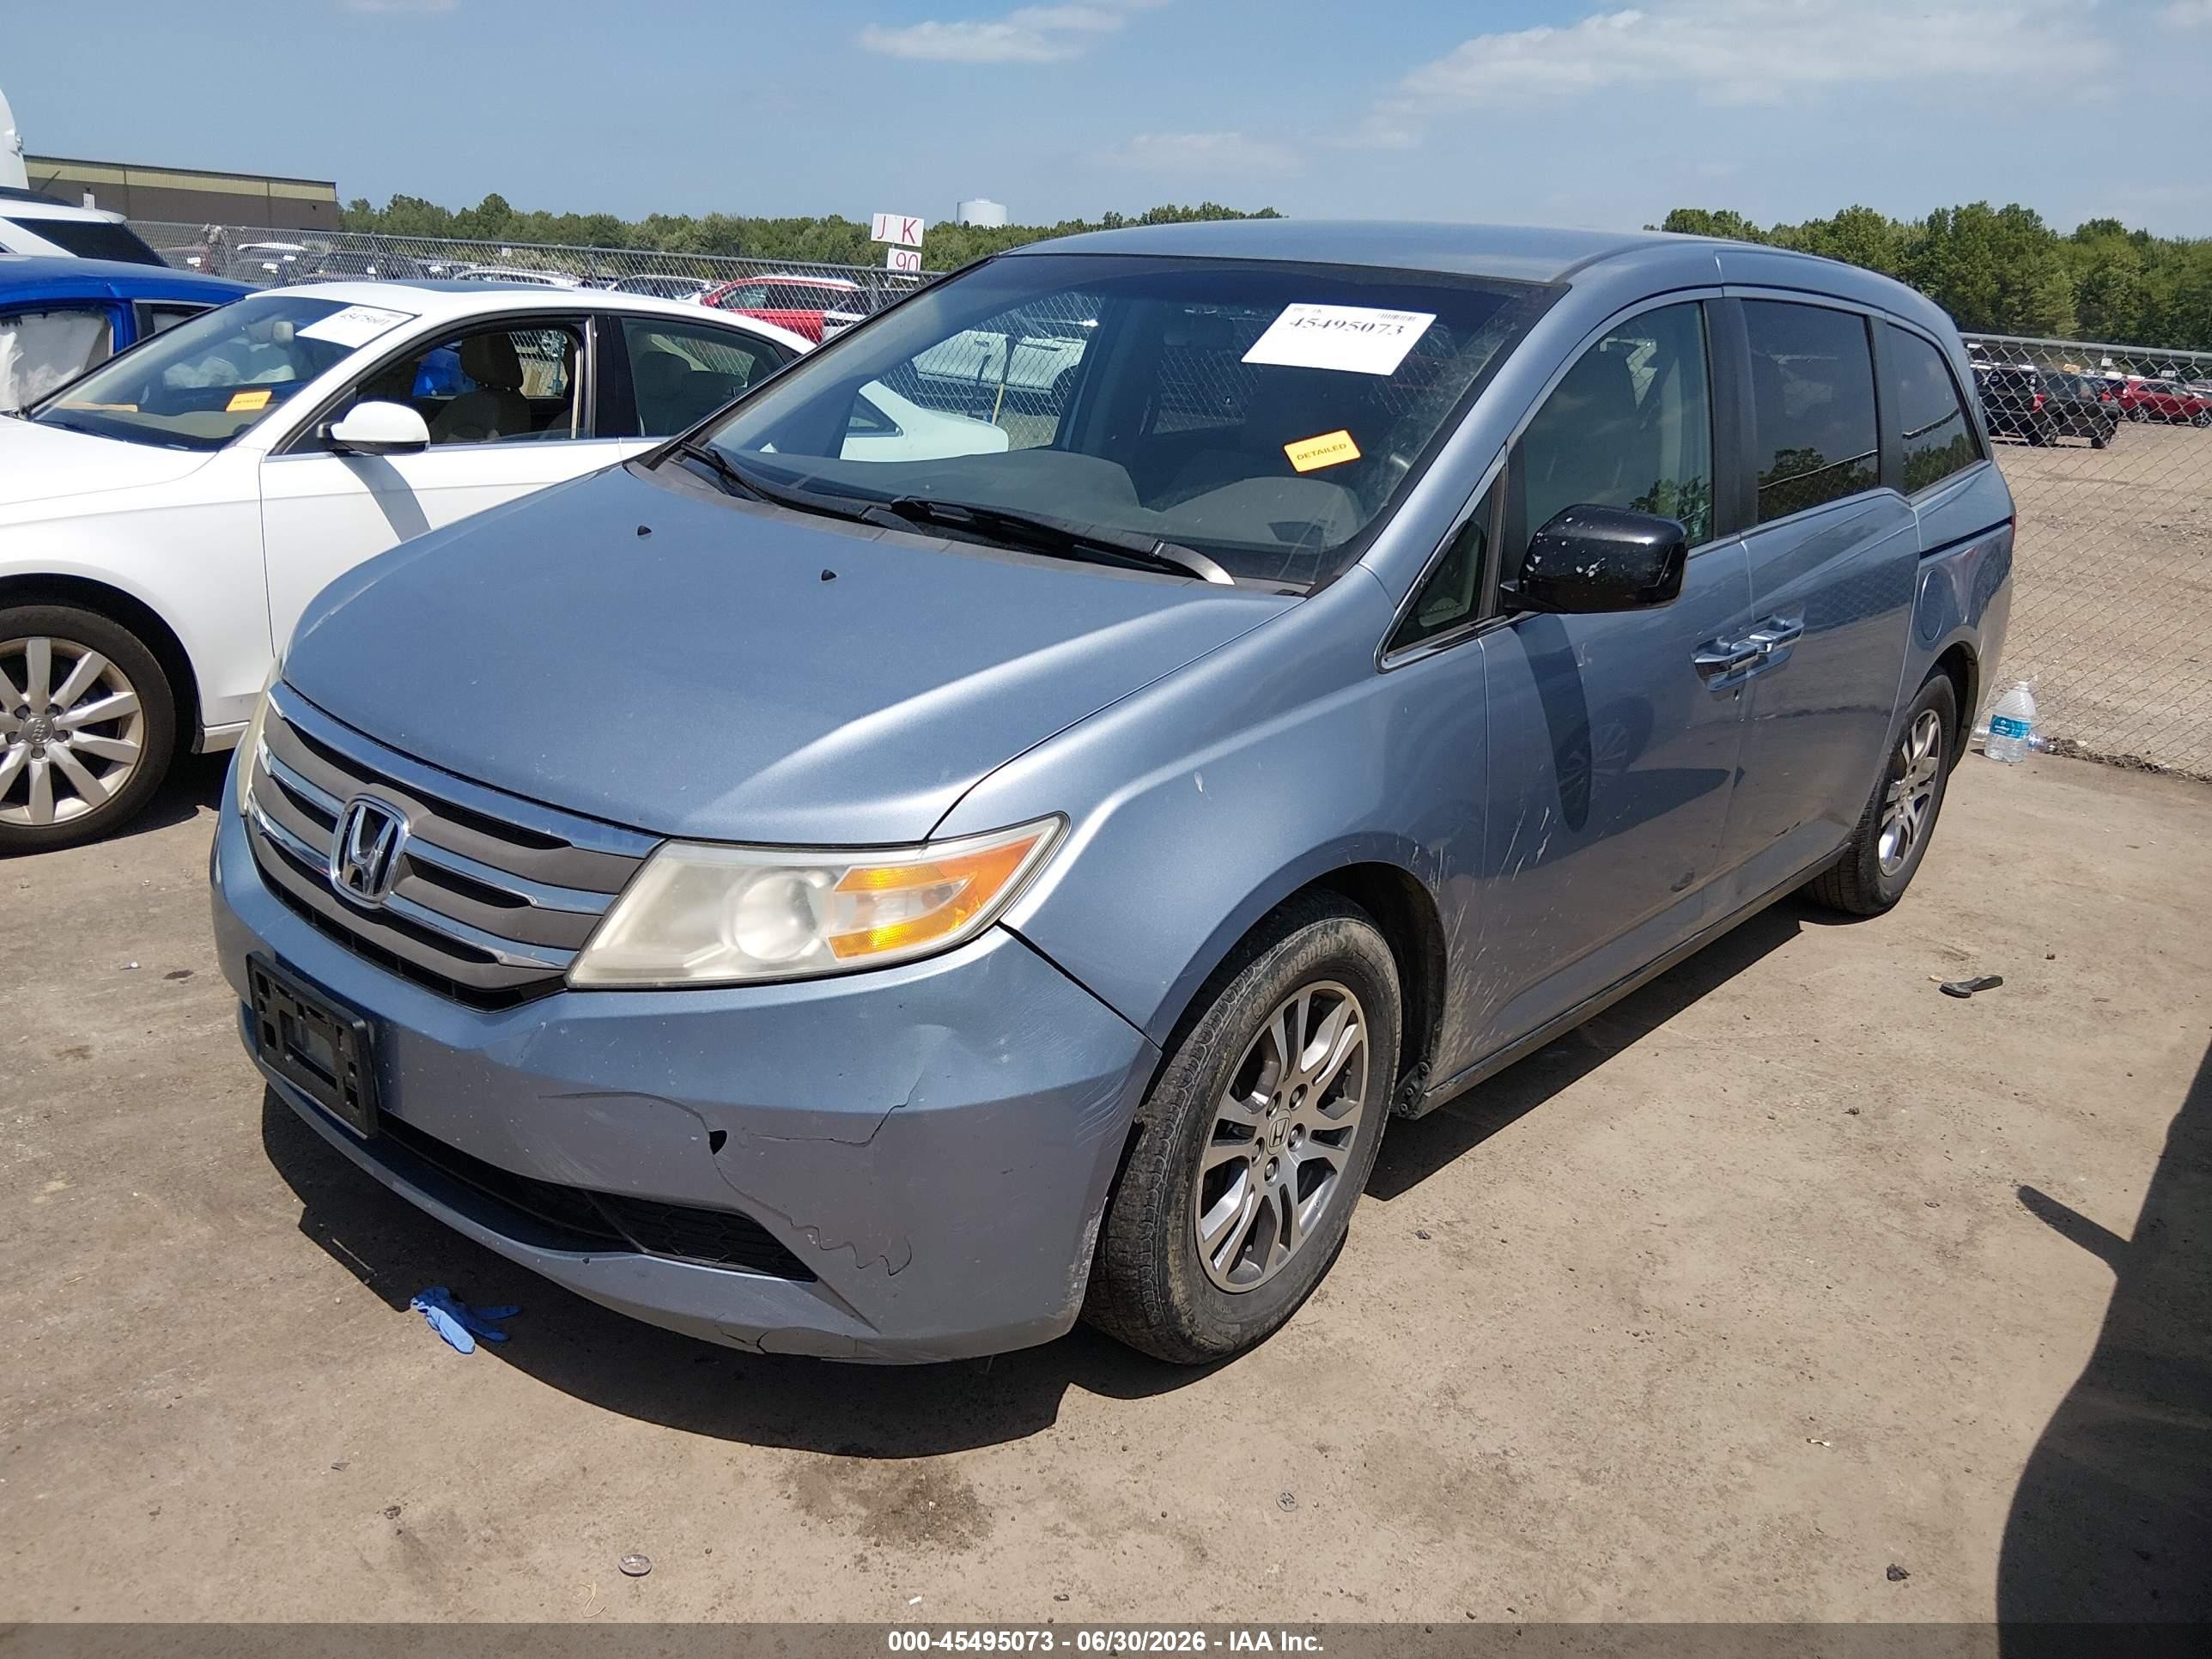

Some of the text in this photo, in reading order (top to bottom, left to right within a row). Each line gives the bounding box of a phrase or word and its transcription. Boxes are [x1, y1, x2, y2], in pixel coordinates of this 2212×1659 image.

[878, 215, 918, 245] J K
[896, 252, 919, 271] 90
[1289, 316, 1406, 336] 45495073
[1296, 442, 1347, 461] DETAILED
